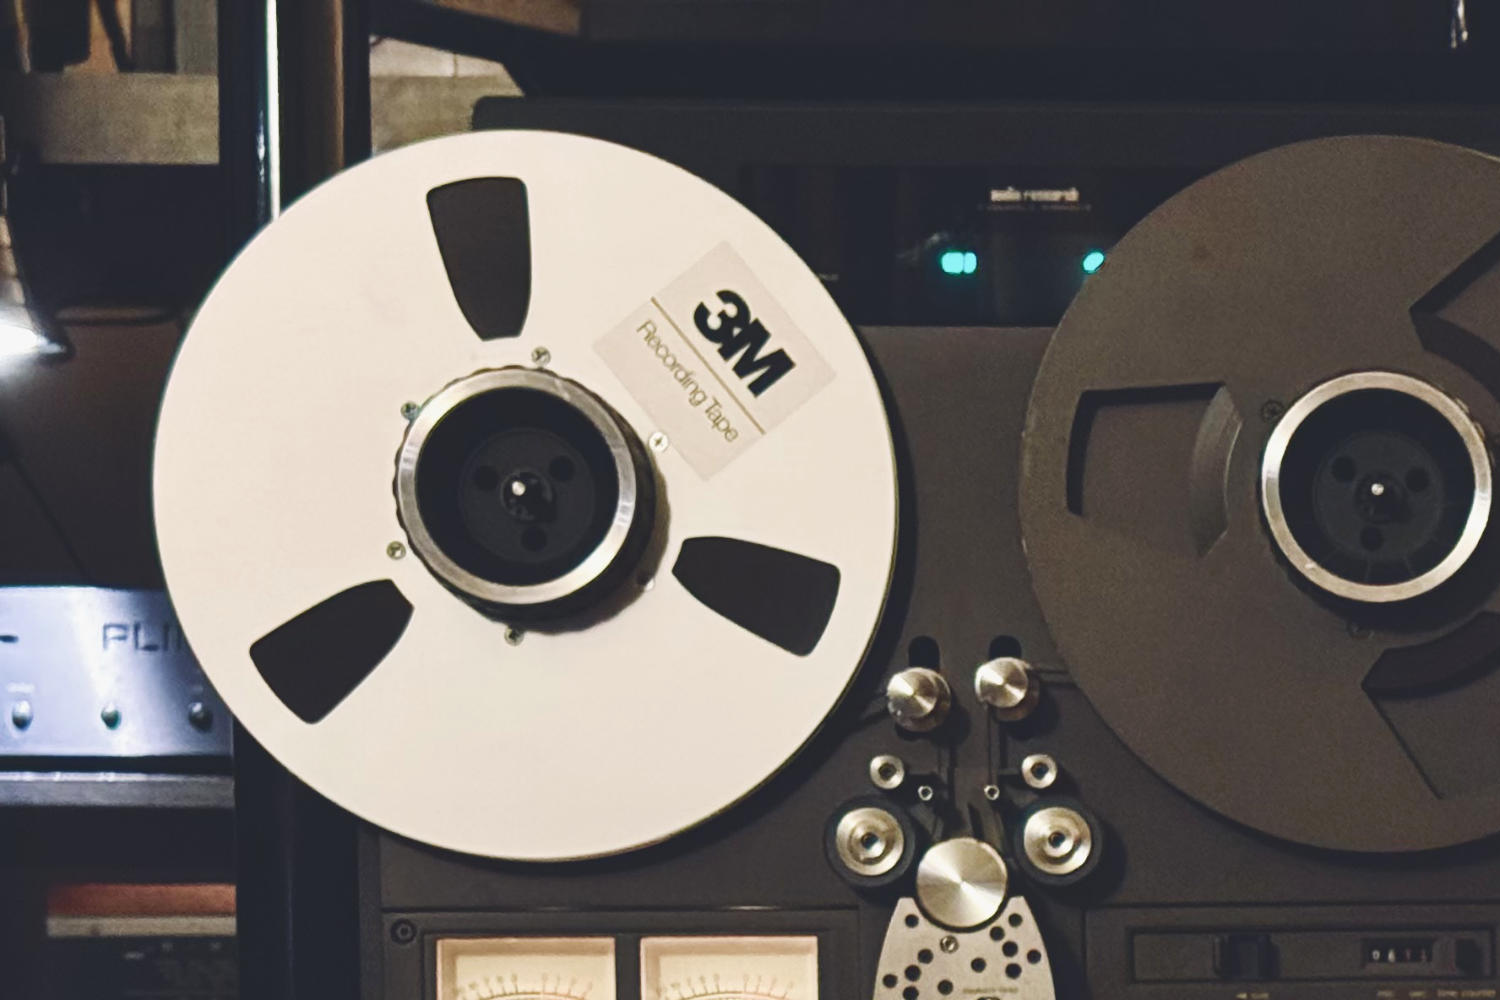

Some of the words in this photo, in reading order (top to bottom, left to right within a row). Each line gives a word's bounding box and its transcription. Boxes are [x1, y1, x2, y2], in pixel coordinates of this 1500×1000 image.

[636, 319, 708, 407] Recording
[704, 396, 739, 443] Tape
[693, 289, 796, 399] 3M
